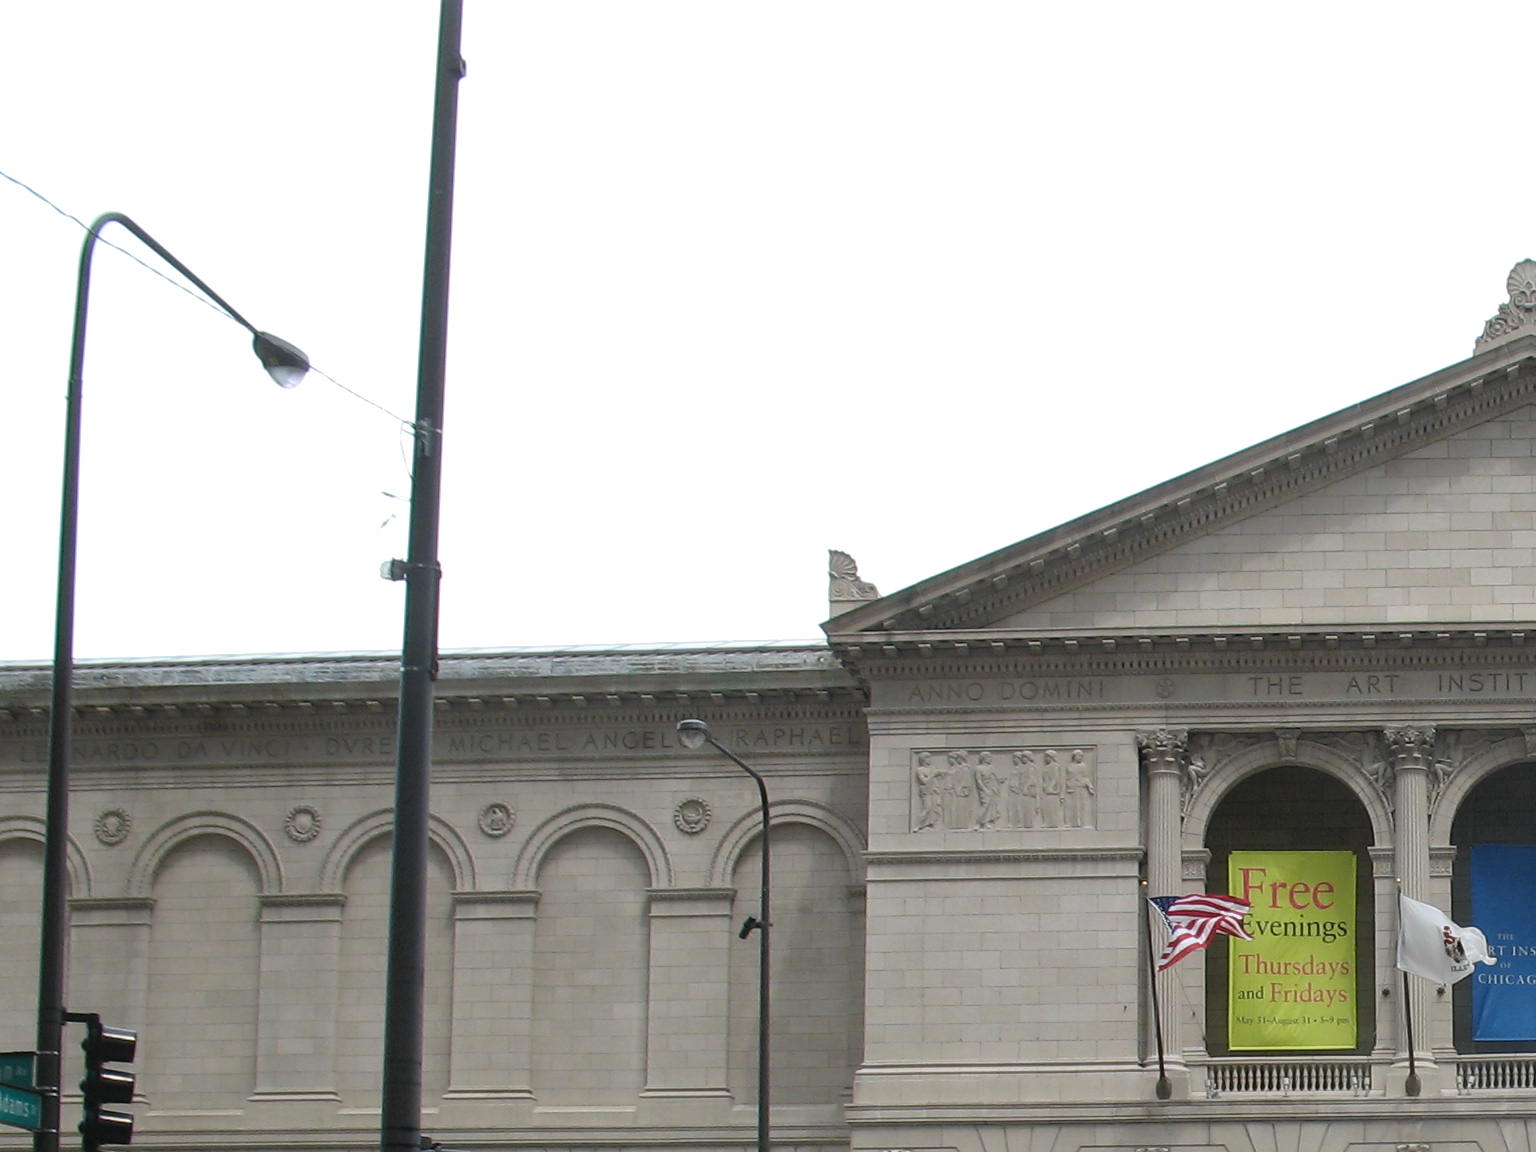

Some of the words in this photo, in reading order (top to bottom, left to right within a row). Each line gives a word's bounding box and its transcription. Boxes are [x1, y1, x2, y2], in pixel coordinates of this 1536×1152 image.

[908, 682, 985, 701] ANNO
[1000, 680, 1104, 700] DOMINI
[1249, 676, 1303, 696] THE
[1345, 674, 1400, 694] ART
[326, 737, 395, 756] DVRE
[447, 732, 569, 753] MICHAEL
[735, 726, 861, 747] RAPHAEL
[20, 741, 158, 763] LENARDO
[177, 739, 208, 759] DA
[1237, 867, 1335, 910] Free
[1496, 933, 1515, 941] THE
[1488, 945, 1504, 957] RT
[1238, 953, 1350, 981] Thursdays
[1500, 961, 1512, 969] OF
[1238, 986, 1264, 1000] and
[1269, 982, 1348, 1008] Fridays
